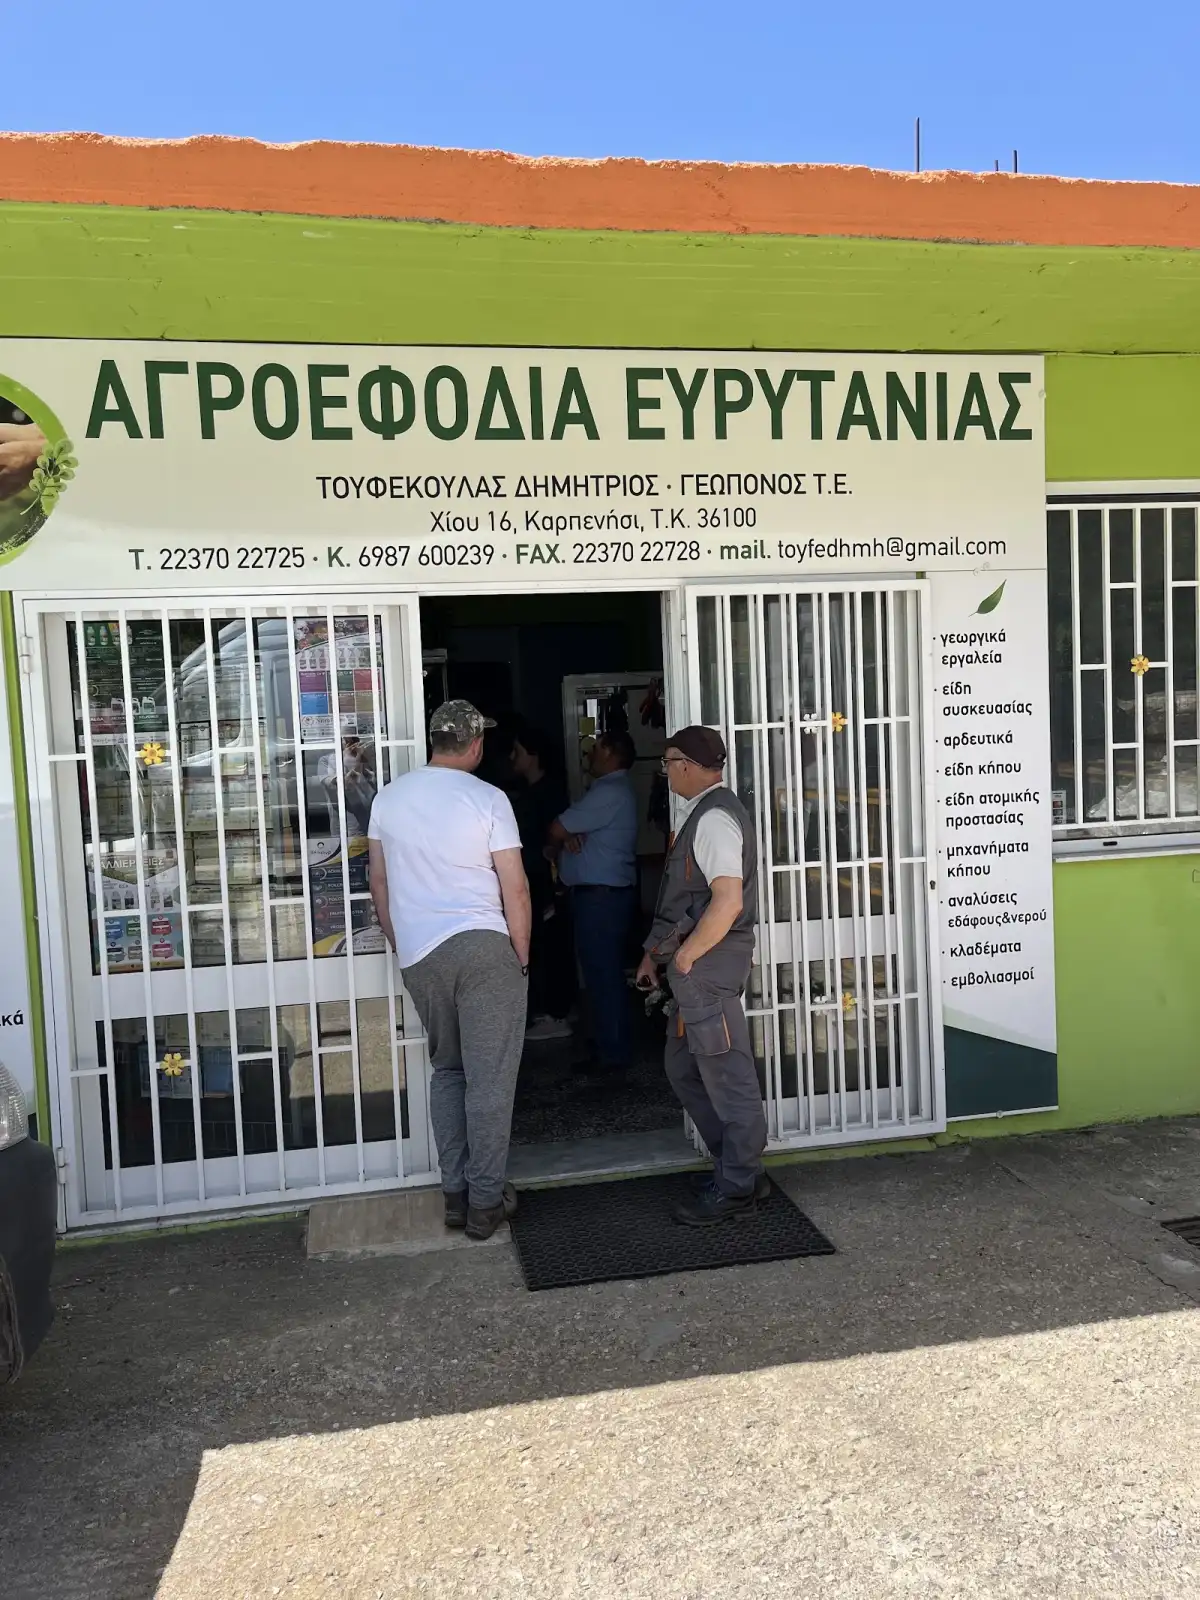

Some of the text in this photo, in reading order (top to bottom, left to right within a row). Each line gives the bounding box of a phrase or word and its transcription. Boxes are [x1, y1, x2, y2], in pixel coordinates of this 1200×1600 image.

[84, 359, 1033, 441] ΑΓΡΟΕΦΟΔΙΑ ΕΥΡΥΤΑΝΙΑΣ
[315, 473, 853, 499] ΤΟΥΦΕΚΟΥΛΑΣ ΔΗΜΗΤΡΙΟΣ ΓΕΩΠΟΝΟΣ Τ.Ε.
[430, 507, 757, 537] Χίου 16, Καρπενήσι, Τ.Κ. 36100
[159, 547, 230, 570] 22370
[236, 546, 305, 569] 22725
[358, 545, 411, 567] 6987
[418, 544, 495, 566] 600239
[515, 543, 566, 565] FAX.
[572, 541, 634, 564] 22370
[640, 540, 701, 562] 22728
[720, 539, 771, 560] mail.
[777, 536, 1006, 564] toyfedhmh@gmail.com
[940, 628, 1006, 647] γεωργικά
[941, 649, 1002, 668] εργαλεία
[942, 681, 972, 696] είδη
[942, 699, 1033, 717] συσκευασίας
[943, 729, 1013, 749] αρδευτικά
[944, 760, 1022, 777] είδη κήπου
[945, 792, 974, 807] είδη
[979, 788, 1040, 807] ατομικής
[945, 810, 1024, 831] προστασίας
[946, 840, 1029, 860] μηχανήματα
[947, 863, 991, 878] κήπου
[948, 891, 1018, 908] αναλύσεις
[948, 908, 1047, 930] εδάφους&νερού
[950, 941, 1022, 958] κλαδέματα
[951, 966, 1035, 990] εμβολιασμοί
[0, 1009, 23, 1026] κά
